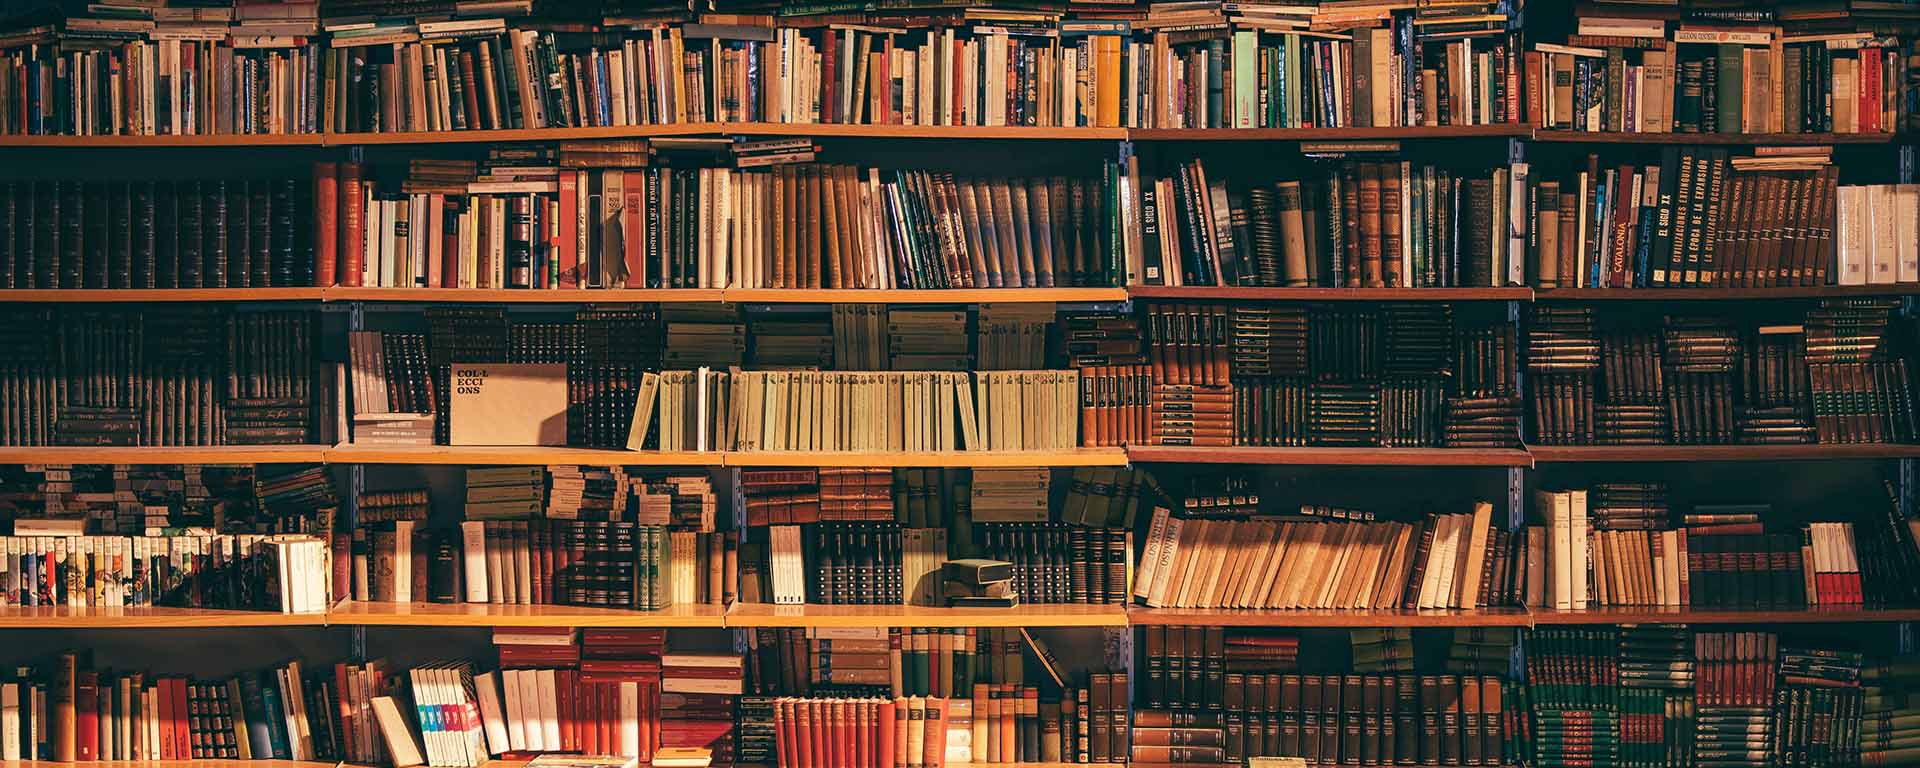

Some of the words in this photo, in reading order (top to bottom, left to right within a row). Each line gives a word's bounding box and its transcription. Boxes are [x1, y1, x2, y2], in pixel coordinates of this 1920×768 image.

[1678, 155, 1692, 204] EXTINGUIDAS
[1144, 192, 1154, 202] XX
[1661, 194, 1671, 205] XX
[1692, 203, 1703, 212] LA
[1704, 254, 1712, 262] LA
[1710, 160, 1724, 202] OCCIDENTAL
[1146, 206, 1154, 224] SIGLO
[1660, 208, 1670, 226] SIGLO
[1692, 216, 1702, 224] DE
[1146, 226, 1156, 234] EL
[1658, 228, 1668, 237] EL
[1673, 206, 1687, 263] CIVILIZACIONES
[1614, 222, 1626, 272] CATALONIA
[1688, 254, 1698, 262] LA
[457, 386, 480, 394] ONS
[1150, 513, 1166, 556] PARNASO
[1162, 524, 1178, 567] PARNASO
